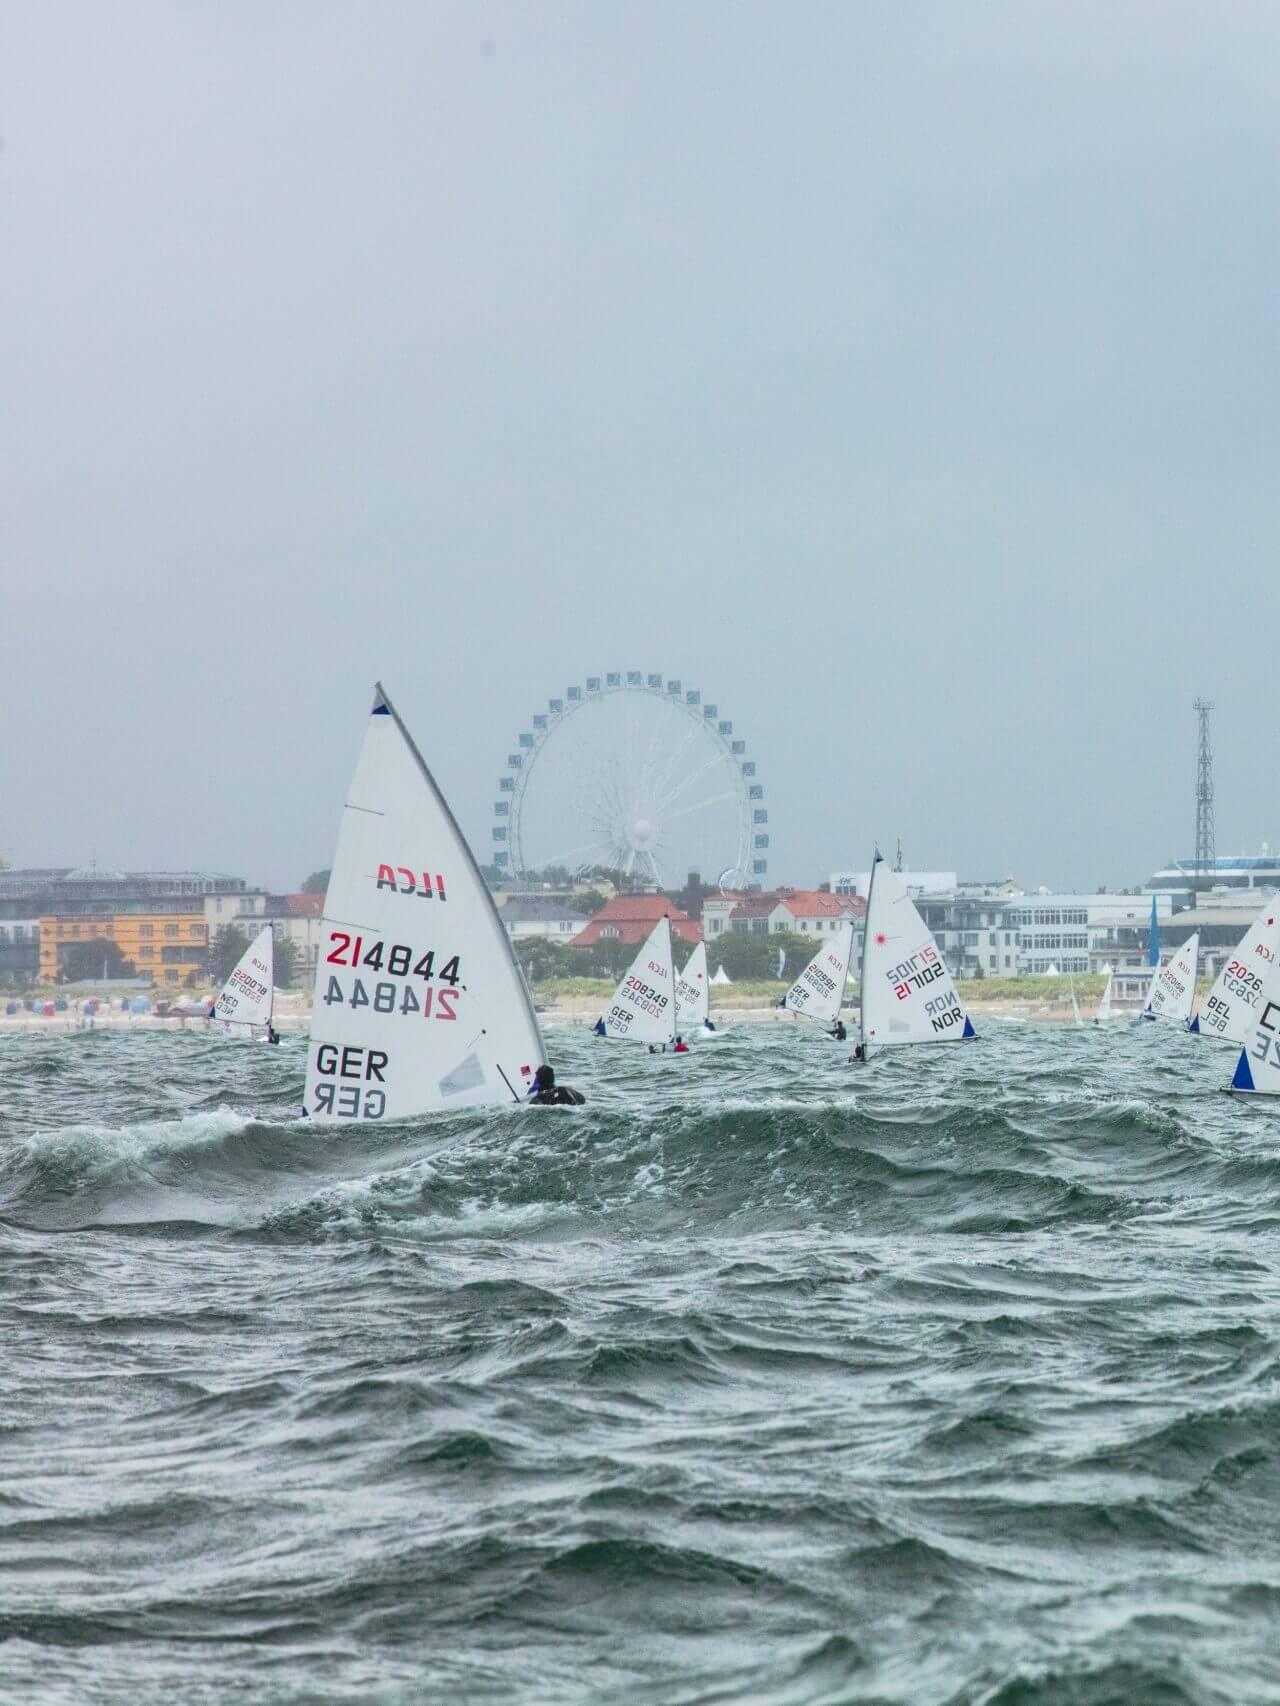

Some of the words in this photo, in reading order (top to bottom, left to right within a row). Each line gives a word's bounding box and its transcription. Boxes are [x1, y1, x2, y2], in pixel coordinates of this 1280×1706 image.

[326, 932, 460, 986] 214844
[233, 969, 268, 996] 220078
[808, 962, 837, 991] 210996
[893, 961, 945, 1001] 217102
[1227, 961, 1264, 996] 2026
[220, 993, 239, 1008] NED
[626, 976, 669, 1008] 208349
[792, 983, 810, 1001] GER
[611, 1006, 634, 1023] GER
[931, 1007, 964, 1033] NOR
[1207, 996, 1233, 1021] BEL
[316, 1044, 389, 1082] GER
